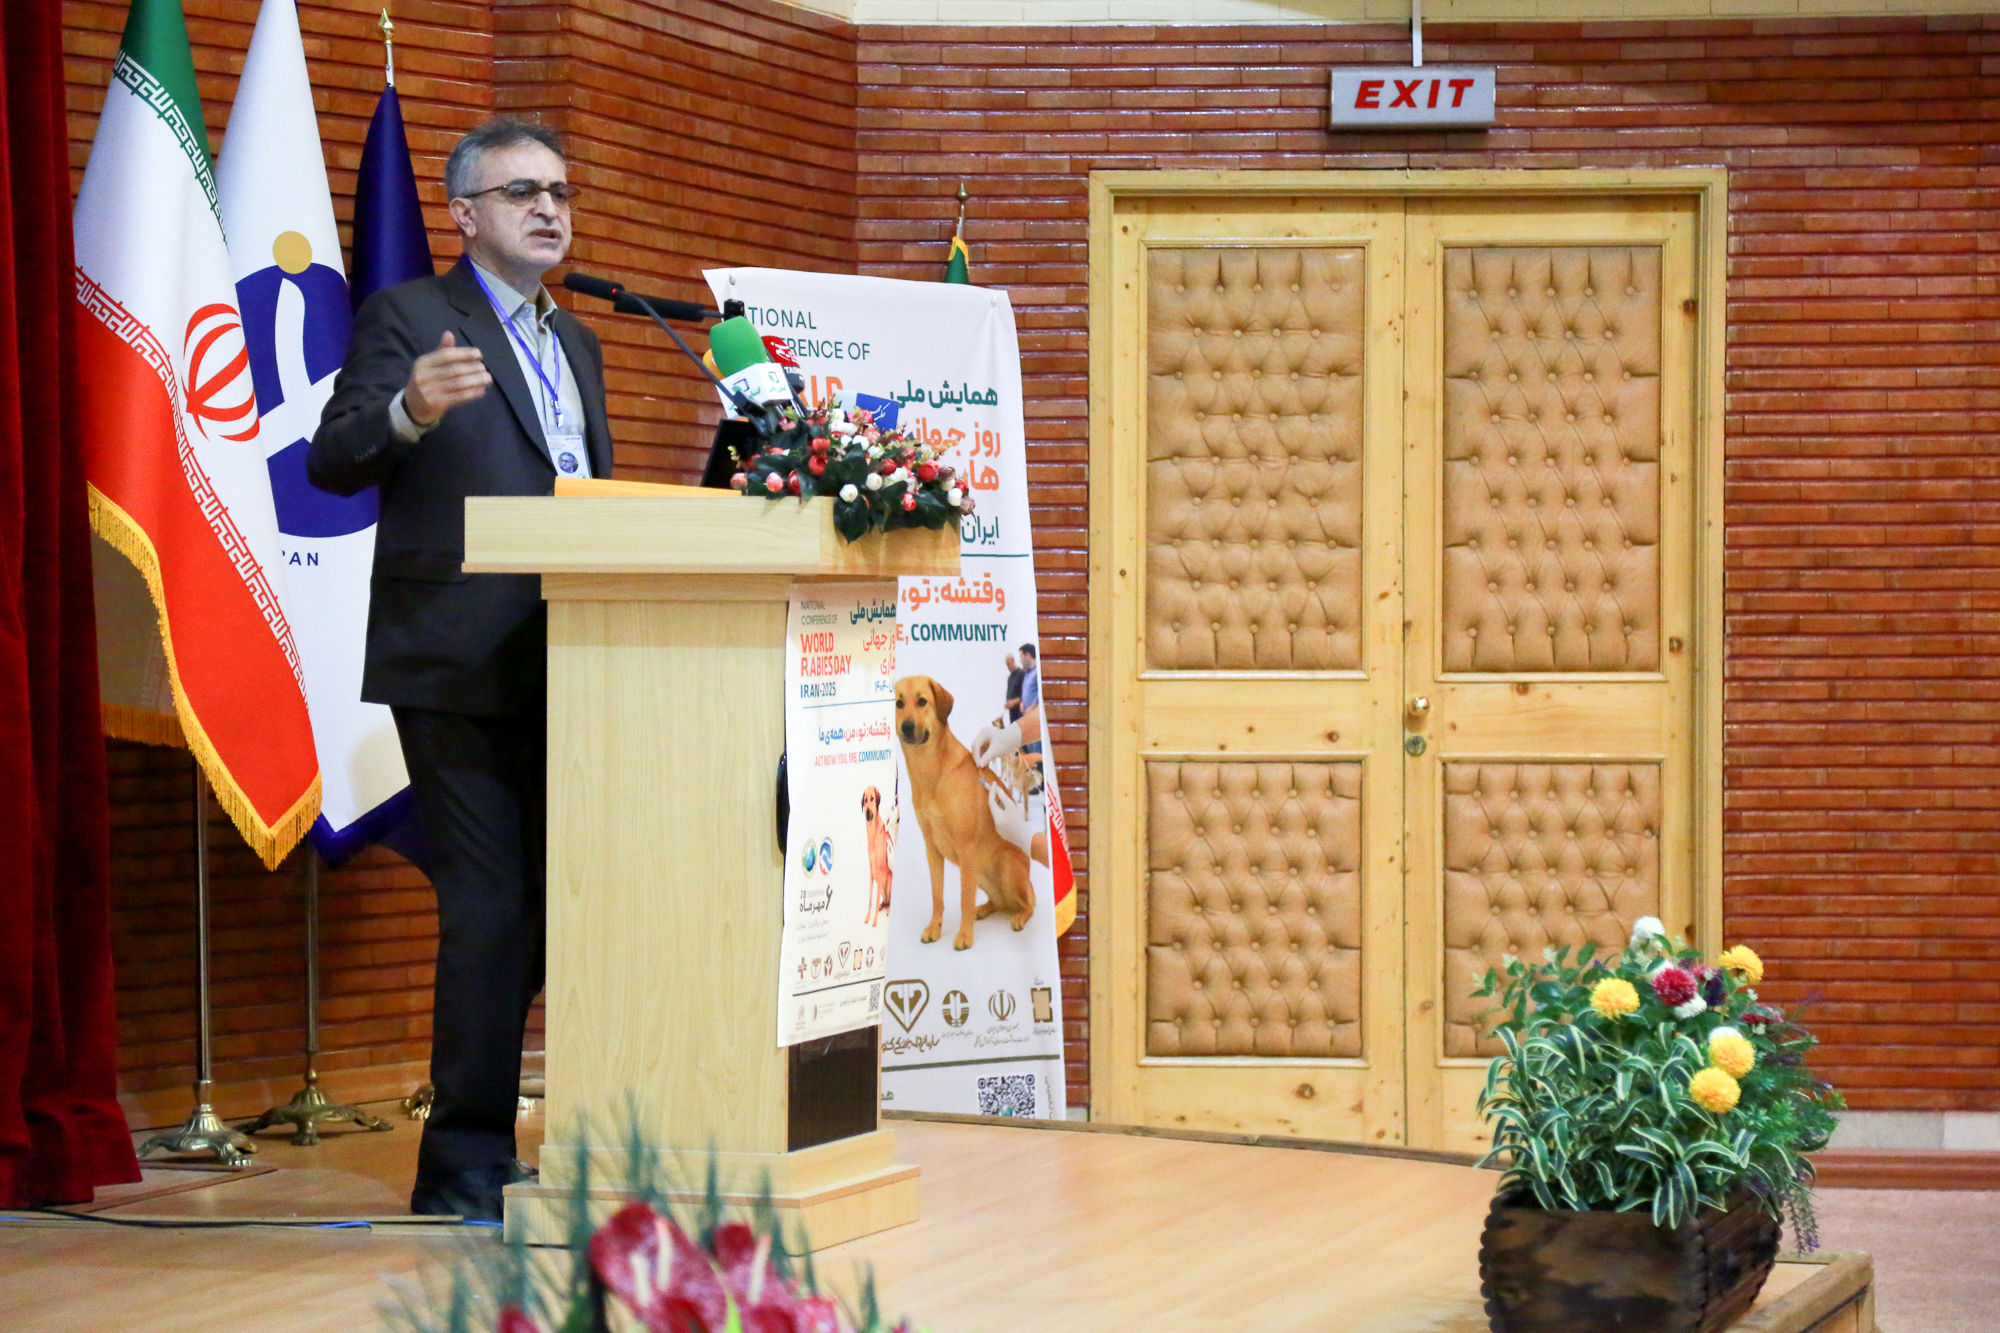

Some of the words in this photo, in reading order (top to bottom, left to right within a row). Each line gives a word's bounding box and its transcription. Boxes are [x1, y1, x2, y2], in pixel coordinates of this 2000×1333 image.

[1354, 79, 1475, 109] EXIT
[746, 306, 817, 330] TIONAL
[780, 337, 844, 360] RENCE
[847, 342, 871, 361] OF
[928, 380, 998, 412] همایش
[969, 421, 1001, 458] روز
[961, 515, 999, 545] ایران
[282, 550, 319, 567] AN
[850, 601, 866, 625] ملی
[800, 632, 834, 653] WORLD
[911, 623, 1008, 642] COMMUNITY
[859, 749, 891, 762] COMMUNITY
